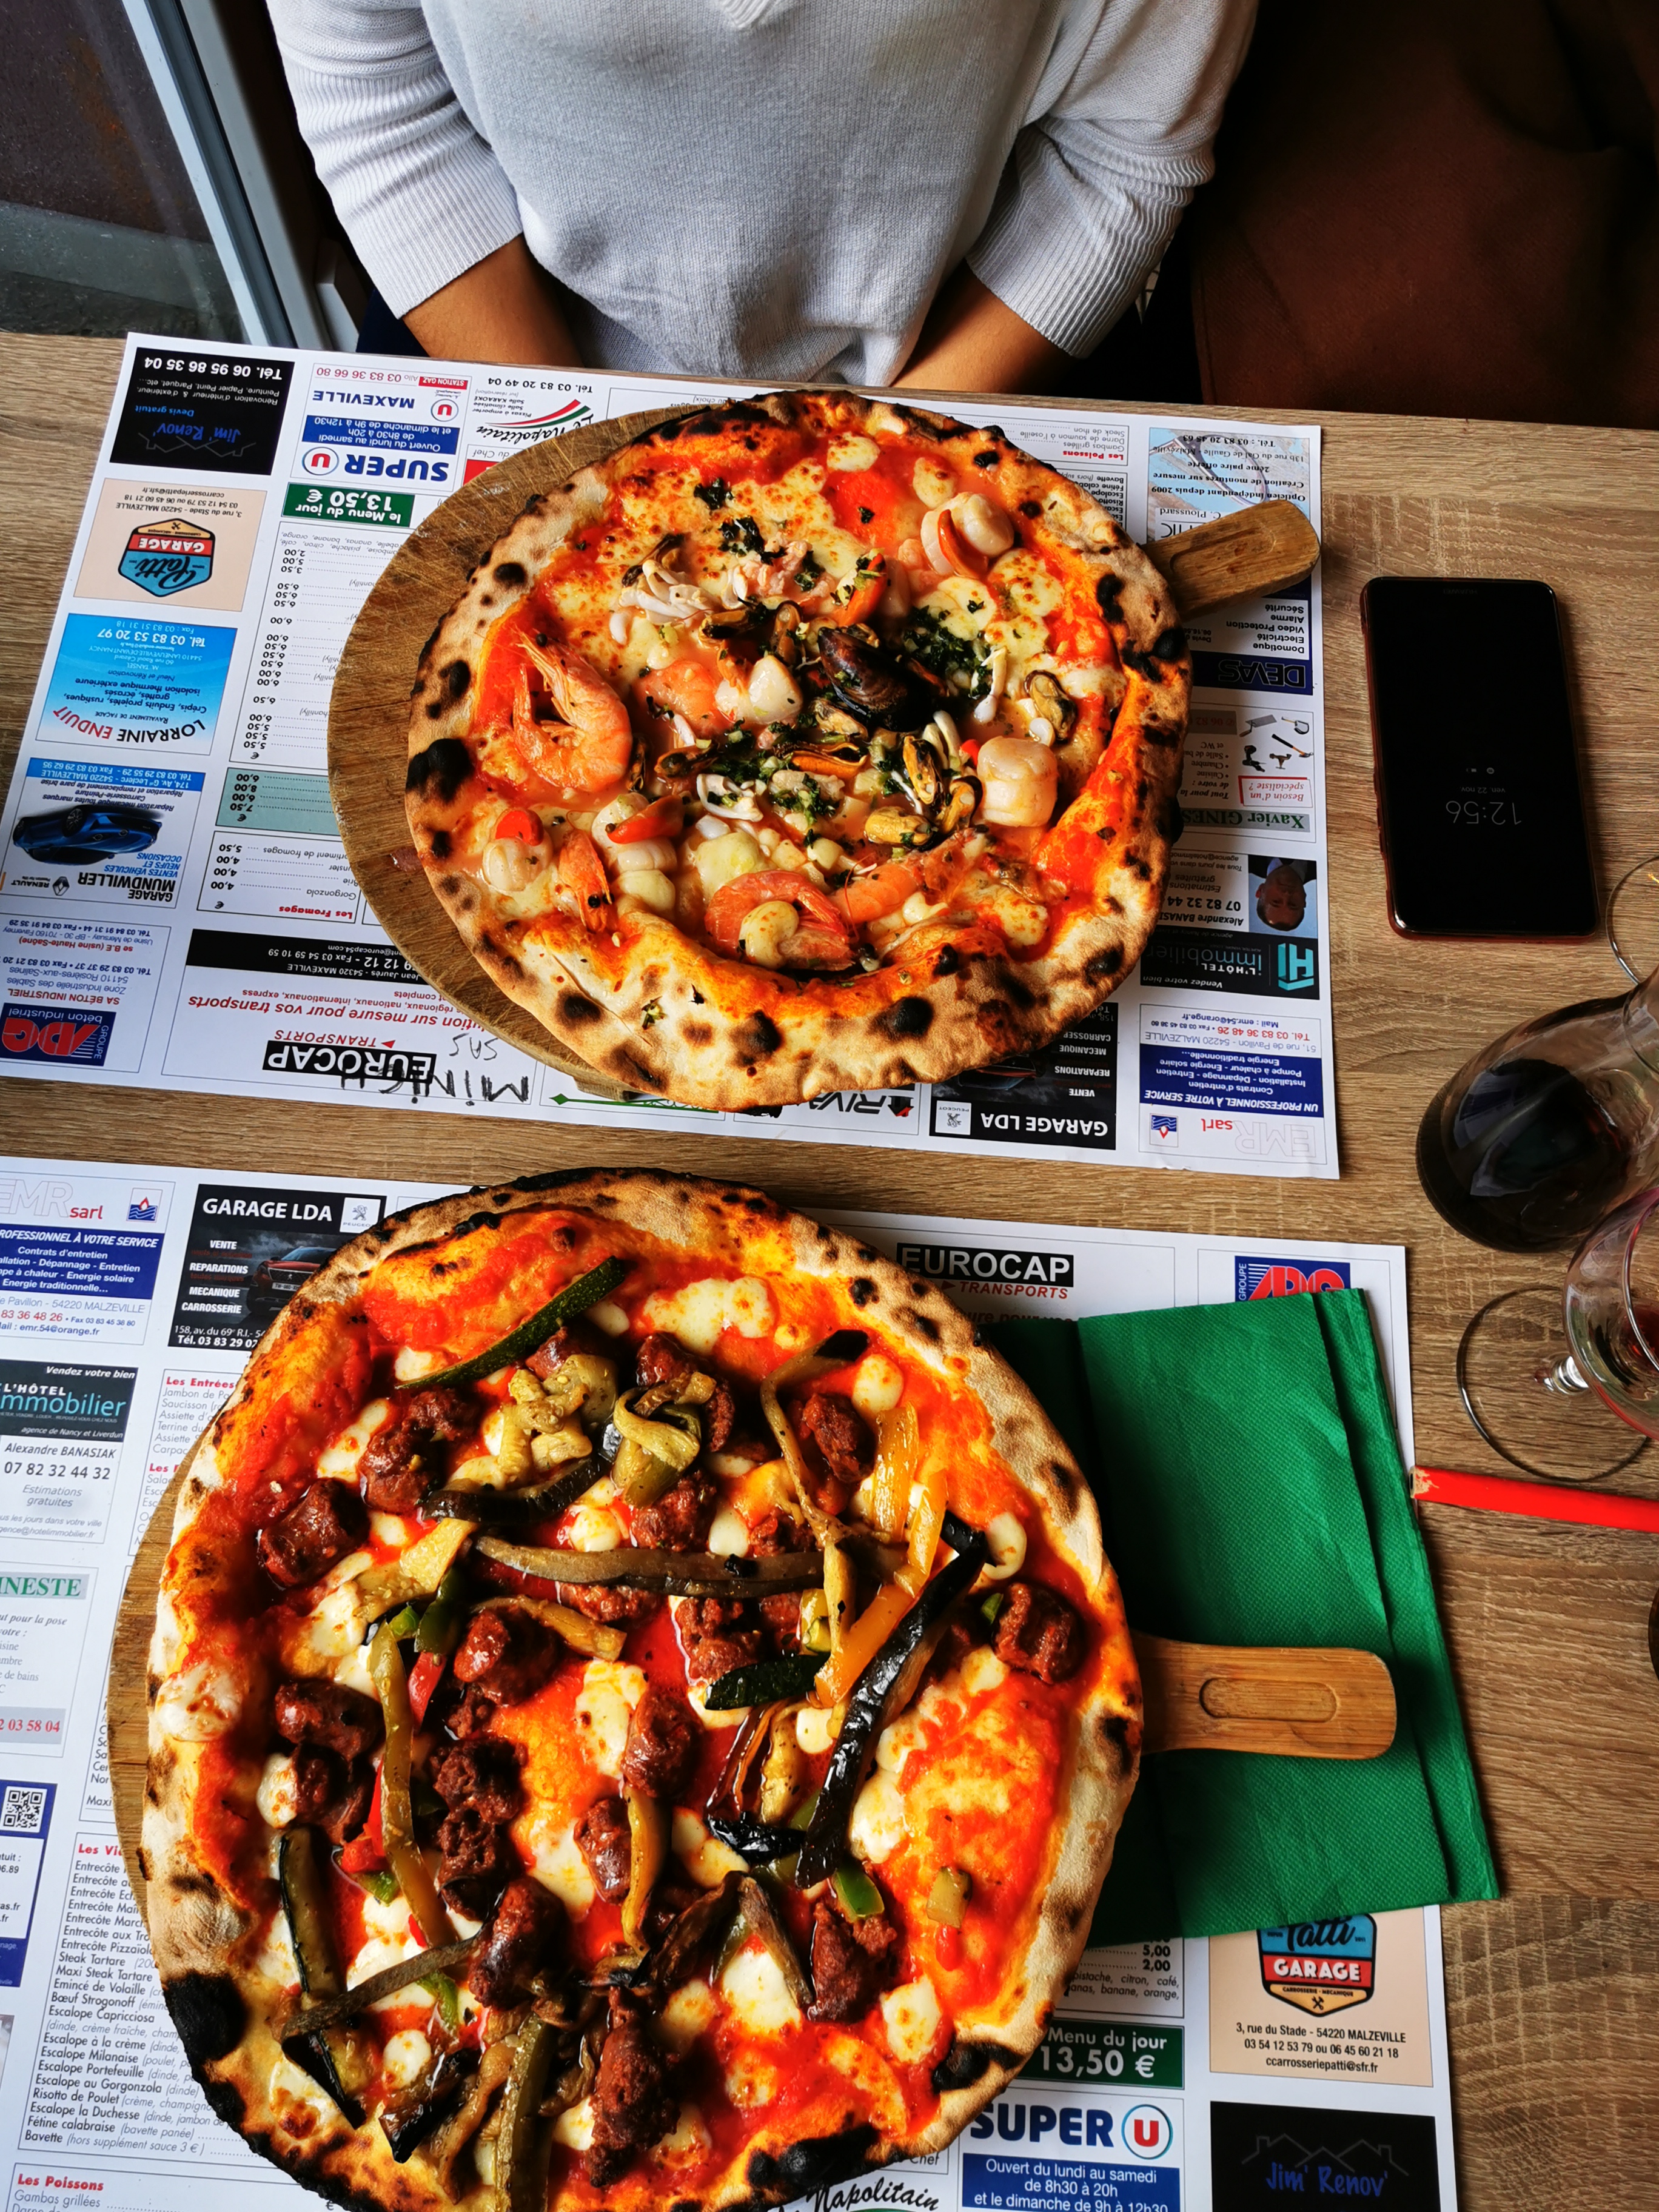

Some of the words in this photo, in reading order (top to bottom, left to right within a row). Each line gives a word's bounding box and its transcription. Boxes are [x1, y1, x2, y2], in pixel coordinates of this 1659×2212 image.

[144, 357, 163, 369] 04
[166, 359, 185, 371] 35
[189, 361, 207, 373] 86
[210, 363, 229, 375] 95
[233, 365, 251, 377] 06
[256, 367, 282, 380] Tél.
[437, 377, 464, 386] STATION
[313, 390, 415, 409] MAXEVILLE
[314, 417, 343, 426] 12h30
[383, 423, 429, 434] dimanche
[1073, 427, 1090, 435] thon
[311, 453, 330, 468] U
[1062, 450, 1104, 460] Poissons
[344, 454, 449, 482] SUPER
[307, 489, 323, 502] €
[330, 492, 393, 511] 13,50
[295, 503, 323, 517] jour
[327, 507, 344, 518] du
[347, 508, 385, 522] Menu
[389, 512, 401, 524] le
[138, 537, 205, 553] GARAGE
[1270, 614, 1304, 624] Alarme
[97, 629, 112, 638] 97
[116, 629, 130, 640] 20
[134, 631, 149, 642] 53
[152, 633, 167, 643] 83
[170, 635, 186, 645] 03
[190, 637, 205, 648] Tél.
[1253, 642, 1305, 654] Domotique
[1218, 660, 1306, 689] DEVAS
[53, 706, 113, 740] ENDUIT
[116, 719, 206, 743] LORRAINE
[1446, 800, 1522, 825] 12:56
[1247, 812, 1305, 829] Xavier
[219, 844, 243, 853] 5,50
[136, 852, 183, 863] OCCASIONS
[11, 880, 50, 889] RENAULT
[78, 871, 176, 893] MUNDWILLER
[210, 881, 235, 890] 4,00
[127, 889, 173, 903] GARAGE
[306, 889, 357, 900] Gorgonzola
[279, 905, 331, 917] Fromages
[335, 911, 353, 919] Les
[1202, 964, 1256, 975] L'HÔTEL
[7, 988, 67, 1000] INDUSTRIEL
[69, 993, 104, 1005] BÉTON
[106, 996, 120, 1005] SA
[188, 996, 270, 1013] transports
[275, 1004, 302, 1014] vos
[8, 1008, 64, 1021] industriel
[306, 1006, 346, 1017] pour
[349, 1010, 408, 1022] mesure
[68, 1013, 102, 1024] béton
[411, 1014, 438, 1025] sur
[93, 1025, 109, 1060] GROUPE
[274, 1029, 377, 1048] TRANSPORTS
[267, 1045, 431, 1080] EUROCAP
[1068, 1088, 1095, 1097] VENTE
[1144, 1090, 1184, 1102] SERVICE
[1184, 1093, 1215, 1105] VOTRE
[1216, 1096, 1224, 1108] À
[1225, 1097, 1302, 1111] PROFESSIONNEL
[1302, 1103, 1319, 1112] UN
[980, 1113, 1020, 1130] LDA
[1026, 1116, 1108, 1136] GARAGE
[1201, 1118, 1233, 1131] sarl
[1233, 1120, 1317, 1159] EMR
[69, 1205, 103, 1219] sarl
[203, 1198, 287, 1218] GARAGE
[292, 1204, 333, 1221] LDA
[209, 1239, 238, 1250] VENTE
[18, 1246, 57, 1256] Contrats
[59, 1249, 108, 1259] d'entretien
[189, 1262, 249, 1275] REPARATIONS
[902, 1247, 1070, 1282] EUROCAP
[1238, 1263, 1247, 1301] GROUPE
[189, 1287, 240, 1299] MECANIQUE
[960, 1282, 1068, 1299] TRANSPORTS
[181, 1302, 242, 1315] CARROSSERIE
[46, 1366, 82, 1376] Vendez
[85, 1369, 111, 1378] votre
[113, 1370, 136, 1379] bien
[4, 1382, 67, 1396] L'HÔTEL
[166, 1376, 185, 1386] Les
[190, 1378, 235, 1389] Entrées
[0, 1392, 127, 1417] mmobilier
[4, 1443, 58, 1455] Alexandre
[61, 1446, 116, 1458] BANASIAK
[4, 1461, 22, 1474] 07
[26, 1463, 44, 1476] 82
[49, 1464, 66, 1477] 32
[70, 1466, 88, 1478] 44
[93, 1467, 110, 1480] 32
[22, 1484, 82, 1496] Estimations
[27, 1498, 73, 1507] gratuites
[1142, 1945, 1171, 1958] 5,00
[59, 1952, 86, 1963] Steak
[91, 1954, 126, 1966] Tartare
[1142, 1958, 1171, 1972] 2,00
[1273, 1958, 1361, 1982] GARAGE
[53, 1978, 89, 1991] Emincé
[92, 1980, 105, 1992] de
[110, 1982, 146, 1995] Volaille
[1121, 1974, 1150, 1986] citron,
[1156, 1975, 1179, 1988] café,
[1101, 1983, 1139, 1998] banane,
[1144, 1989, 1179, 2001] orange,
[1322, 1989, 1354, 1997] MECANIQUE
[49, 2005, 93, 2021] Escalope
[96, 2008, 155, 2023] Capricciosa
[1236, 2022, 1245, 2034] 3,
[1247, 2025, 1262, 2034] rue
[1265, 2024, 1277, 2034] du
[1280, 2025, 1307, 2036] Stade
[1316, 2028, 1345, 2039] 54220
[1348, 2029, 1406, 2043] MALZEVILLE
[1047, 2026, 1096, 2044] Menu
[1103, 2029, 1125, 2046] du
[1132, 2031, 1167, 2053] jour
[41, 2046, 85, 2062] Escalope
[89, 2049, 138, 2063] Milanaise
[1039, 2045, 1124, 2077] 13,50
[1134, 2054, 1155, 2078] €
[1265, 2057, 1378, 2073] ccarrosseriepatti@sfr.fr
[33, 2088, 67, 2100] Risotto
[71, 2091, 84, 2102] de
[87, 2092, 119, 2103] Poulet
[27, 2115, 58, 2128] Fétine
[61, 2118, 115, 2133] calabraise
[970, 2102, 1114, 2148] SUPER
[1133, 2119, 1159, 2147] U
[25, 2130, 62, 2143] Bavette
[986, 2159, 1030, 2174] Ouvert
[1033, 2163, 1050, 2176] du
[1054, 2163, 1085, 2178] lundi
[1090, 2169, 1105, 2180] au
[1110, 2170, 1156, 2183] samedi
[18, 2173, 40, 2186] Les
[45, 2175, 104, 2191] Poissons
[14, 2190, 59, 2206] Gambas
[62, 2195, 100, 2209] grillées
